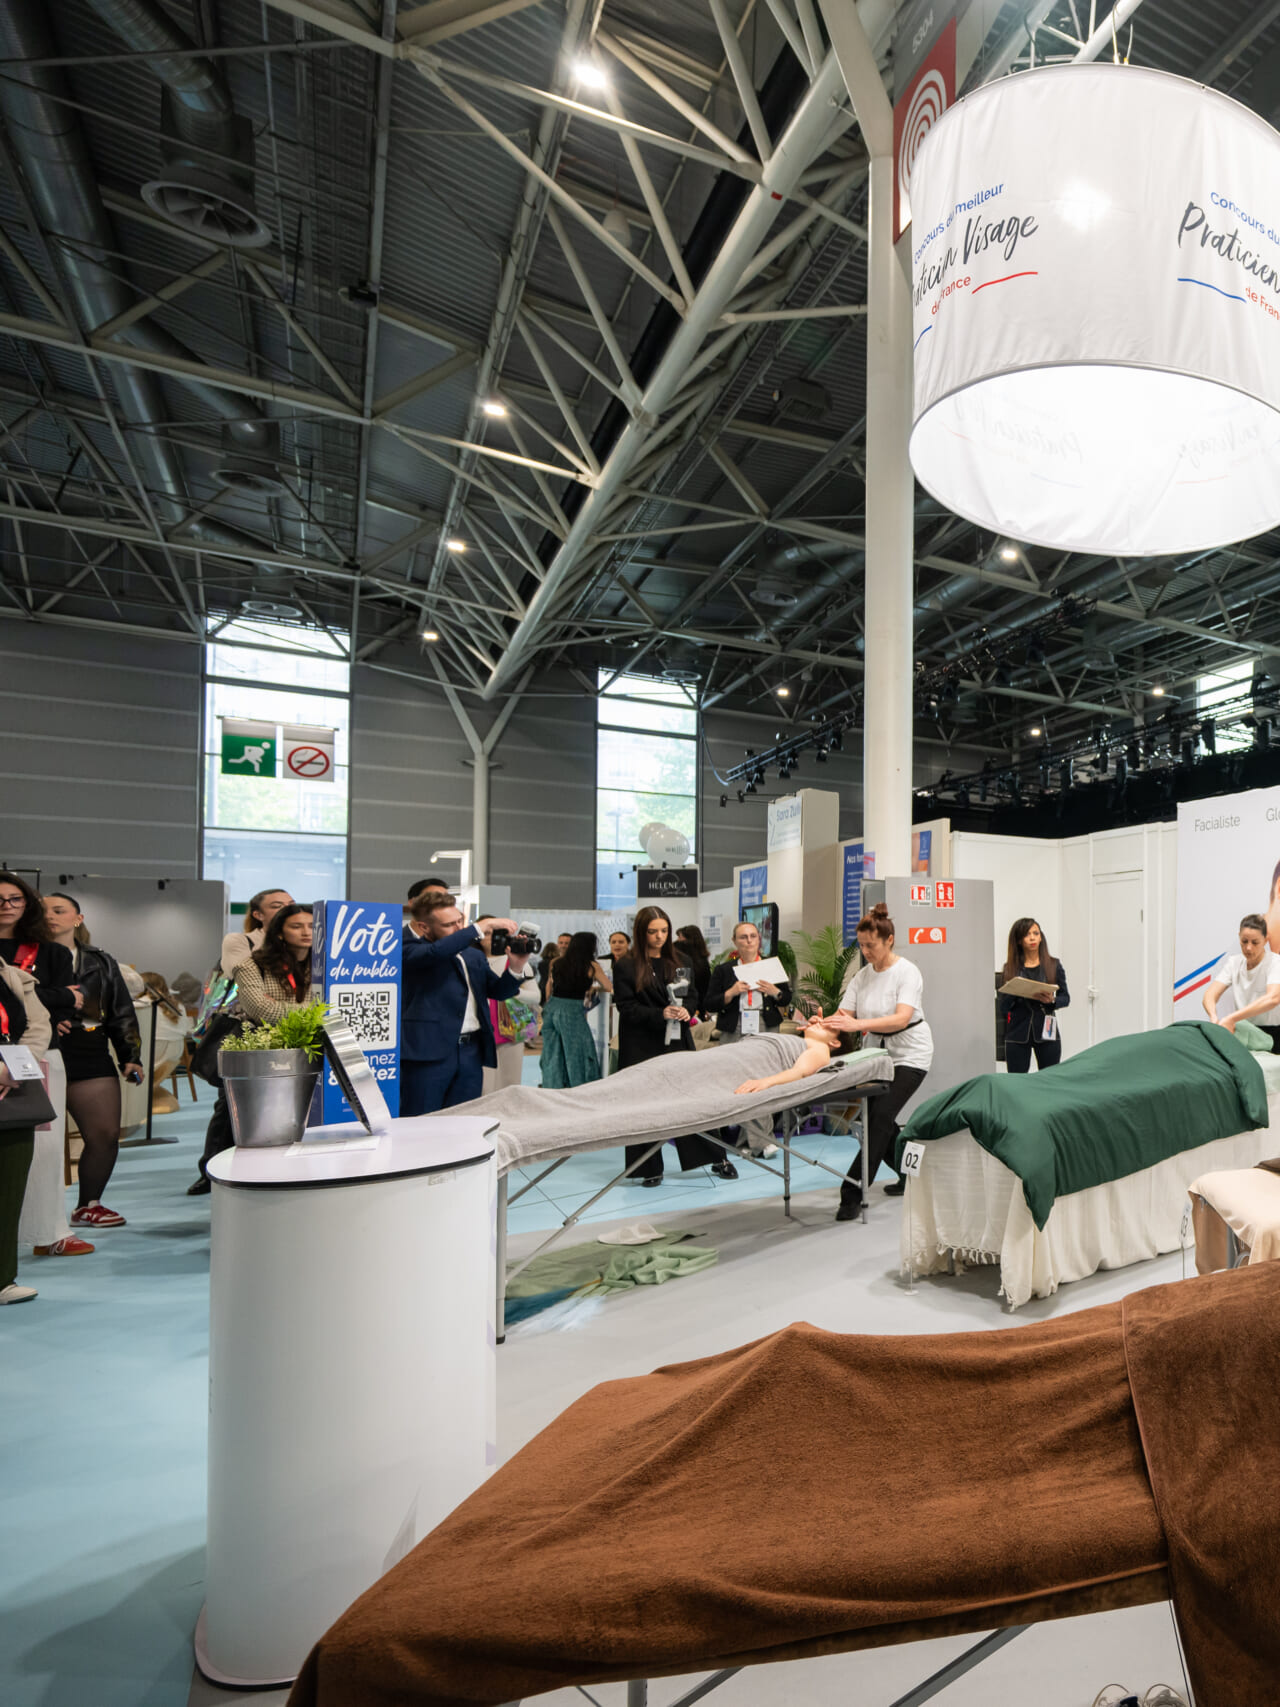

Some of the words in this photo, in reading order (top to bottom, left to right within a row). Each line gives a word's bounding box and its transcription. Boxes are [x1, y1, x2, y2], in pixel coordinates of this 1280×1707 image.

[955, 184, 1004, 215] meilleur
[963, 215, 1039, 264] Visage
[1267, 228, 1280, 245] du
[1245, 287, 1258, 303] de
[1194, 814, 1241, 832] Facialiste
[330, 904, 399, 960] Vote
[329, 958, 350, 981] du
[351, 958, 398, 983] public
[905, 1152, 919, 1170] 02
